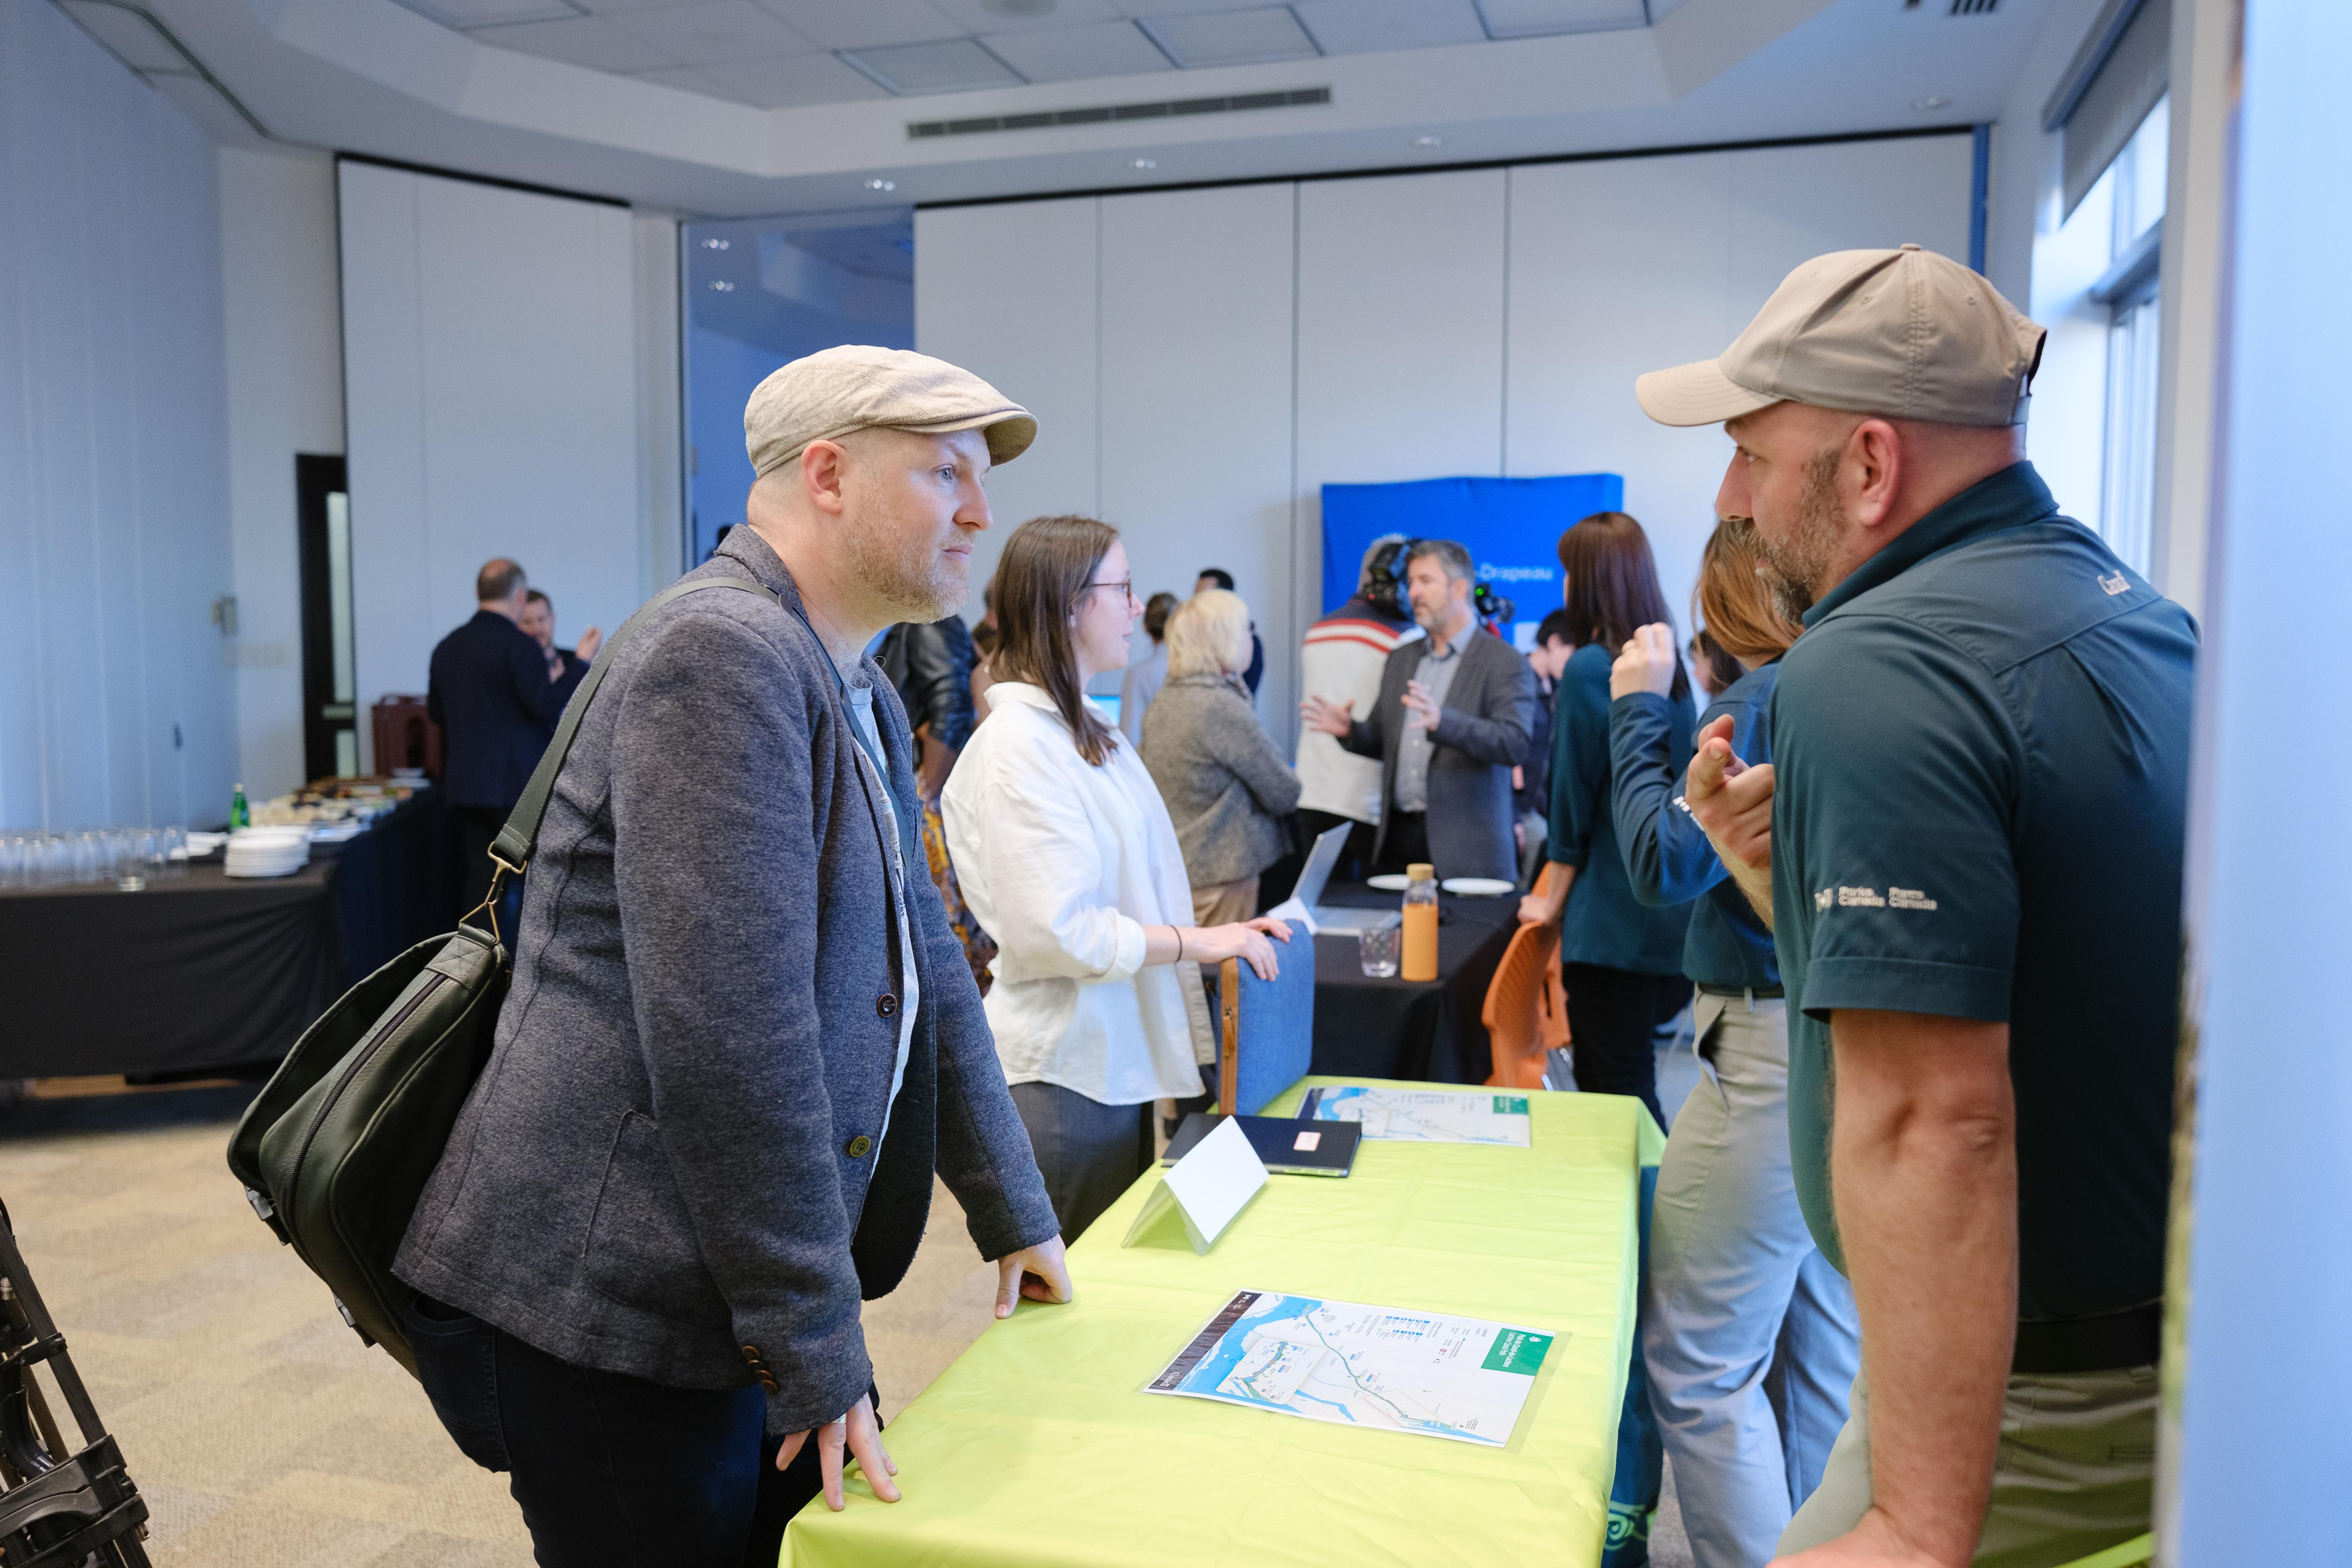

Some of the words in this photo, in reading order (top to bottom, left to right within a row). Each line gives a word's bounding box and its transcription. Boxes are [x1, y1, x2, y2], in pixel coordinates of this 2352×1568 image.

[1838, 896, 1885, 907] Canada
[1889, 898, 1937, 910] Canada
[1159, 1372, 1180, 1387] Canada
